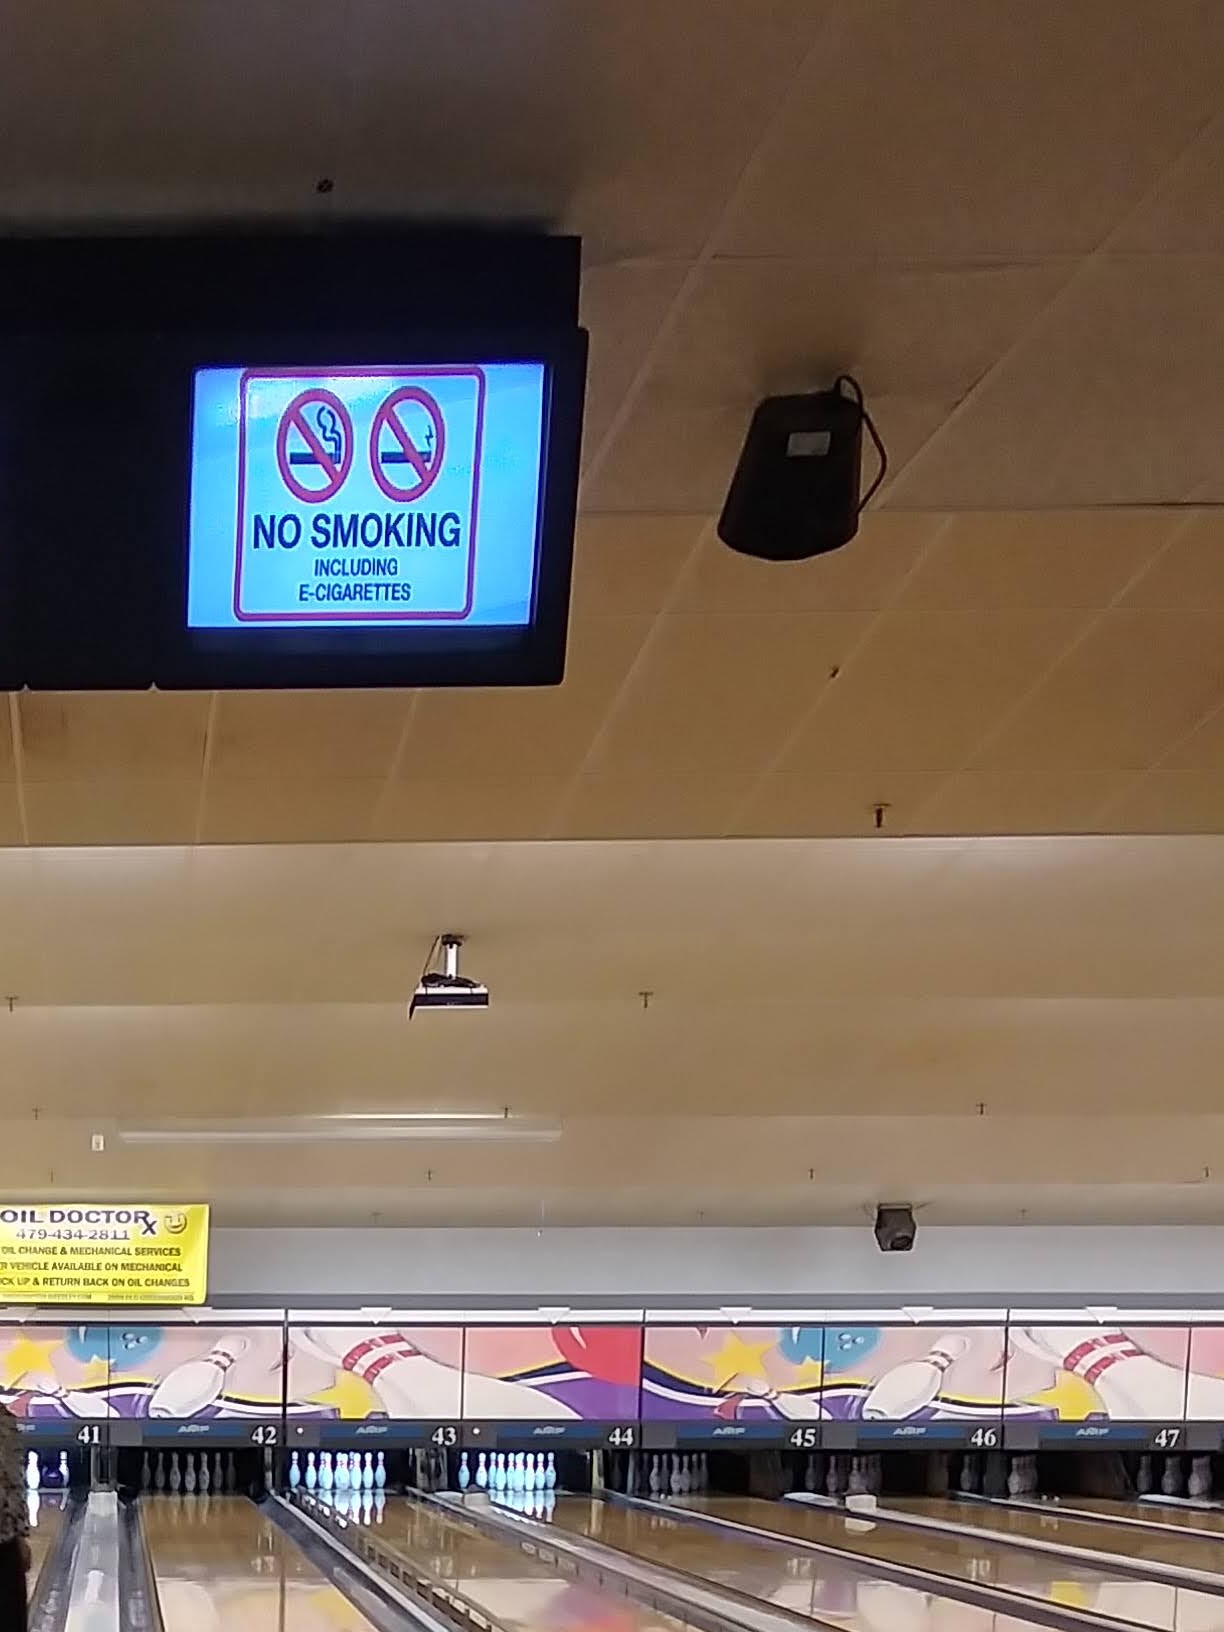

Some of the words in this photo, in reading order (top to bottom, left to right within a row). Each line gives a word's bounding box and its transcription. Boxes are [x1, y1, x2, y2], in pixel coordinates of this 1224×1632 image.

[253, 514, 301, 549] NO
[310, 511, 461, 548] SMOKING
[314, 558, 398, 576] INCLUDING
[299, 582, 412, 602] E-CIGARETTES
[0, 1209, 44, 1224] OIL
[16, 1228, 130, 1240] 479-434-2811
[1, 1246, 16, 1255] OIL
[18, 1246, 58, 1256] CHANGE
[59, 1246, 67, 1255] &
[70, 1246, 132, 1256] MECHANICAL
[134, 1247, 181, 1257] SERVICES
[10, 1261, 50, 1271] VEHICLE
[51, 1261, 102, 1271] AVAILABLE
[104, 1262, 118, 1271] ON
[120, 1262, 183, 1272] MECHANICAL
[32, 1277, 40, 1286] &
[42, 1277, 81, 1287] RETURN
[83, 1277, 109, 1287] BACK
[111, 1278, 125, 1287] ON
[127, 1278, 143, 1287] OIL
[144, 1278, 190, 1287] CHANGES
[78, 1425, 100, 1444] 41
[252, 1425, 277, 1445] 42
[432, 1427, 457, 1446] 43
[609, 1427, 634, 1446] 44
[790, 1428, 816, 1447] 45
[971, 1428, 996, 1447] 46
[1155, 1429, 1180, 1447] 47
